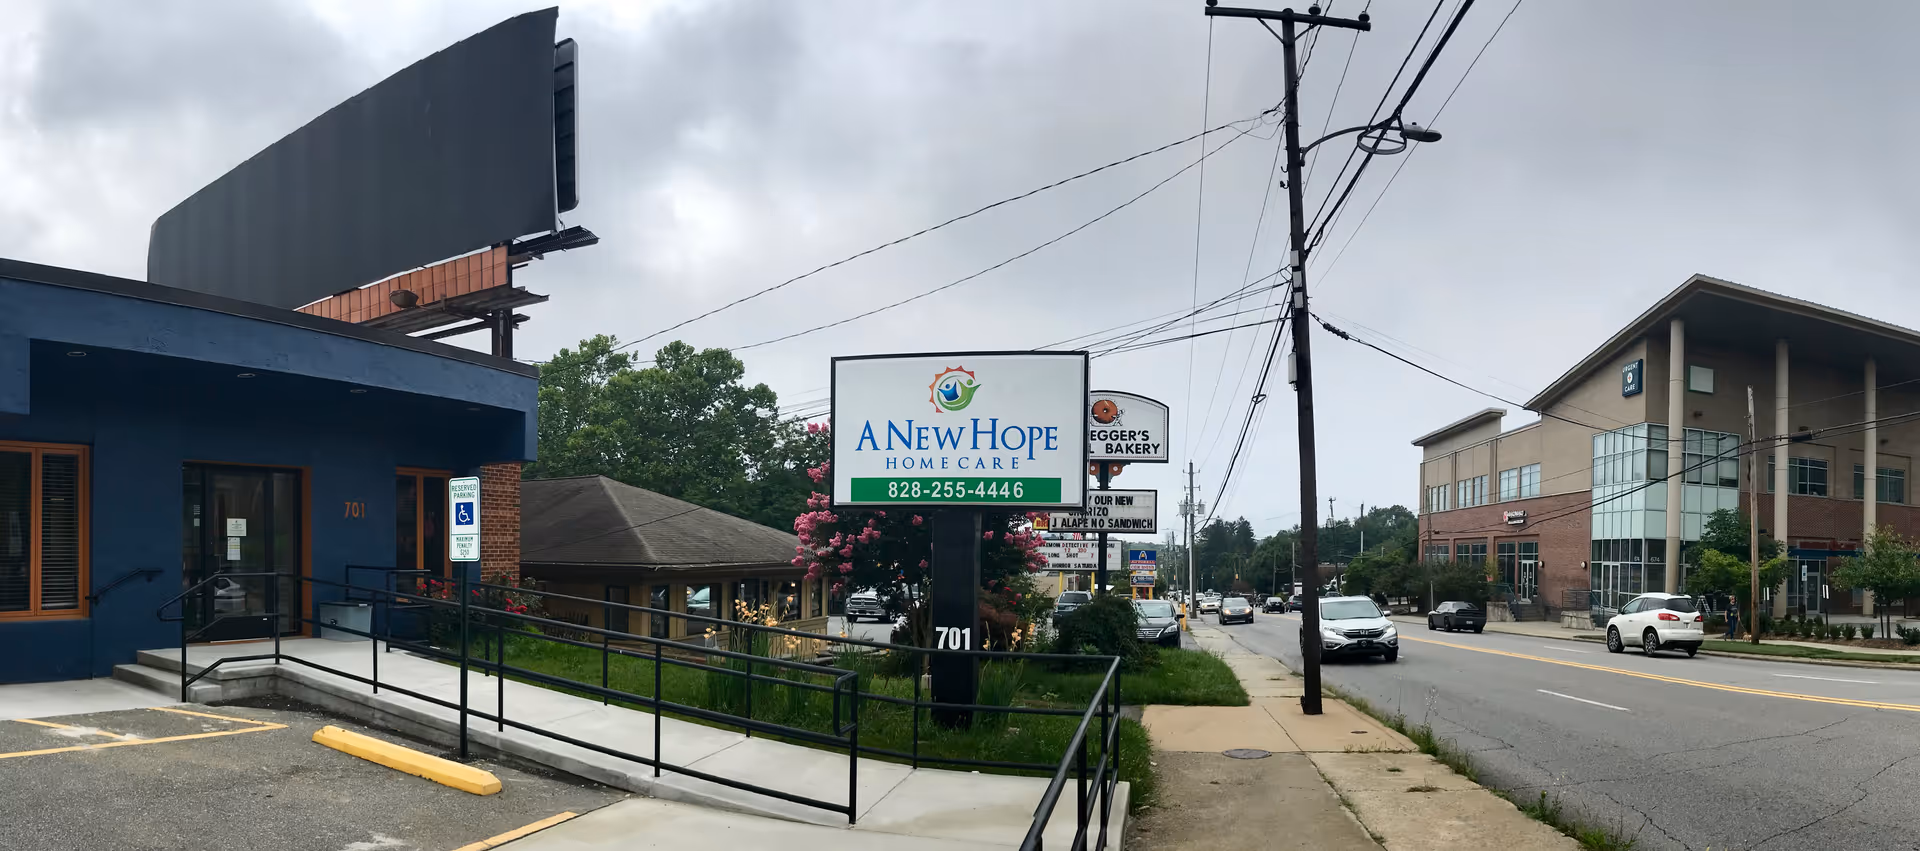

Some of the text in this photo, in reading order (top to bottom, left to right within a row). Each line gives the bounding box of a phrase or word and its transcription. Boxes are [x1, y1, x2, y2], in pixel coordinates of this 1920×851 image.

[1625, 384, 1636, 392] CARE
[855, 418, 1058, 460] A NEW HOPE
[1090, 430, 1150, 441] EGGER'S
[1105, 443, 1160, 454] BAKERY
[452, 484, 477, 492] RESERVED
[888, 481, 1024, 498] 828-255-4446
[1094, 496, 1113, 506] OUR
[1115, 496, 1134, 506] NEW
[344, 502, 365, 519] 701
[1107, 519, 1153, 529] SANDWICH
[935, 626, 971, 650] 701
